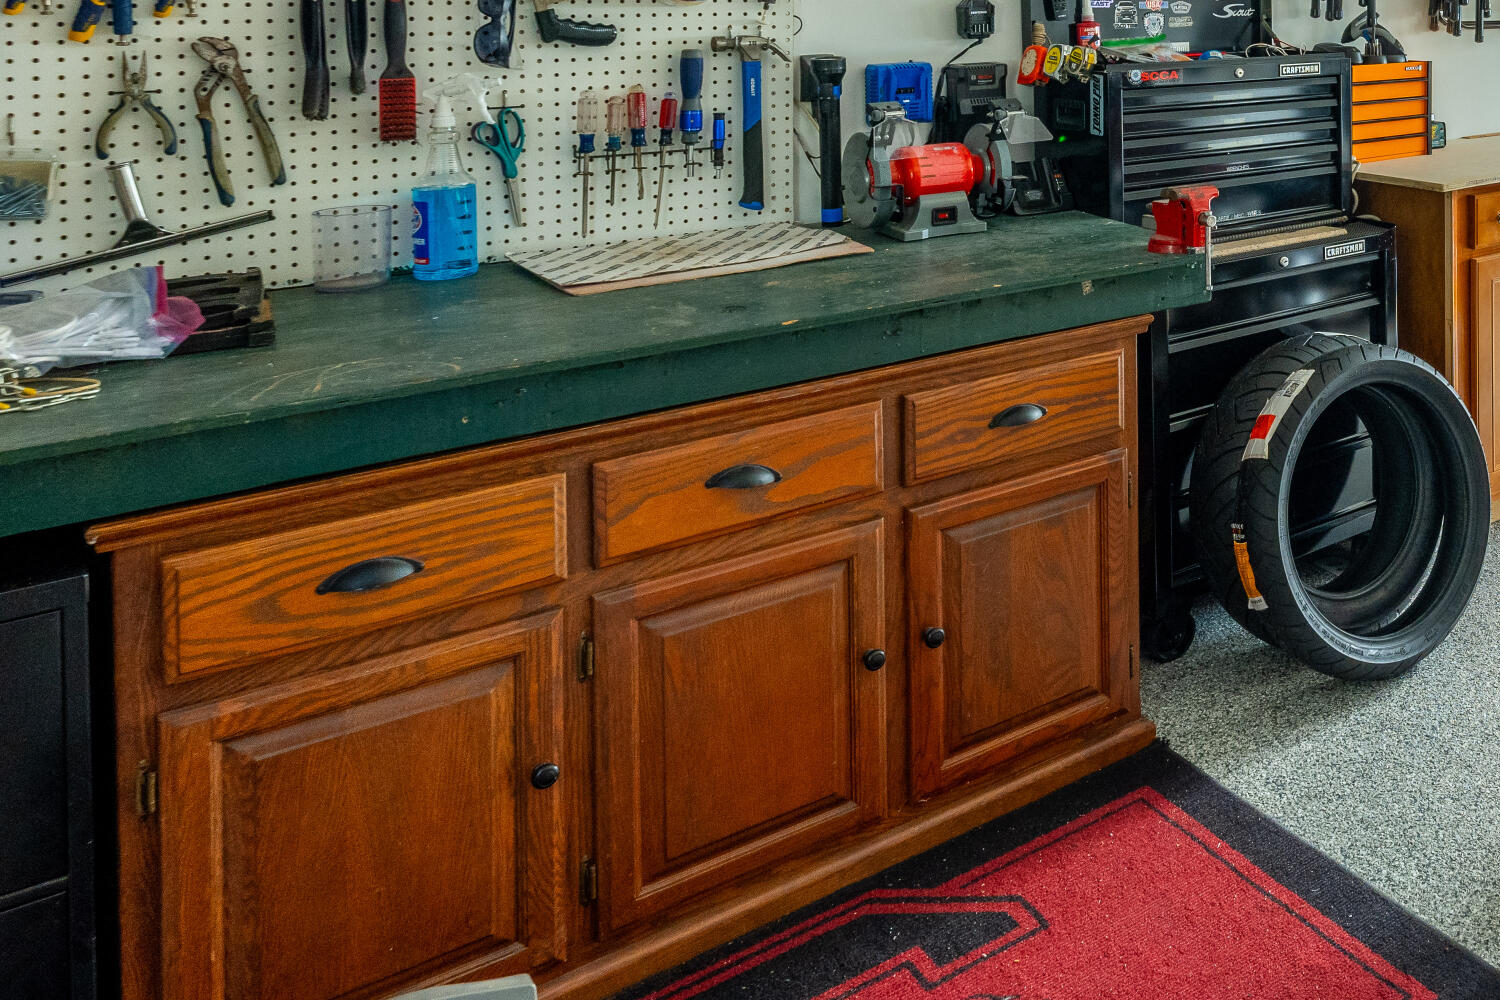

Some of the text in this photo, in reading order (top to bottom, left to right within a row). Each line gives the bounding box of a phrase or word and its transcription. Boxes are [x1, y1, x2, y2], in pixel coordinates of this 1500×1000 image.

[1212, 3, 1256, 19] Scout
[1141, 70, 1179, 82] SCCA
[1282, 64, 1319, 75] CRAFTSMAN
[1327, 242, 1364, 257] CRAFTSMAN
